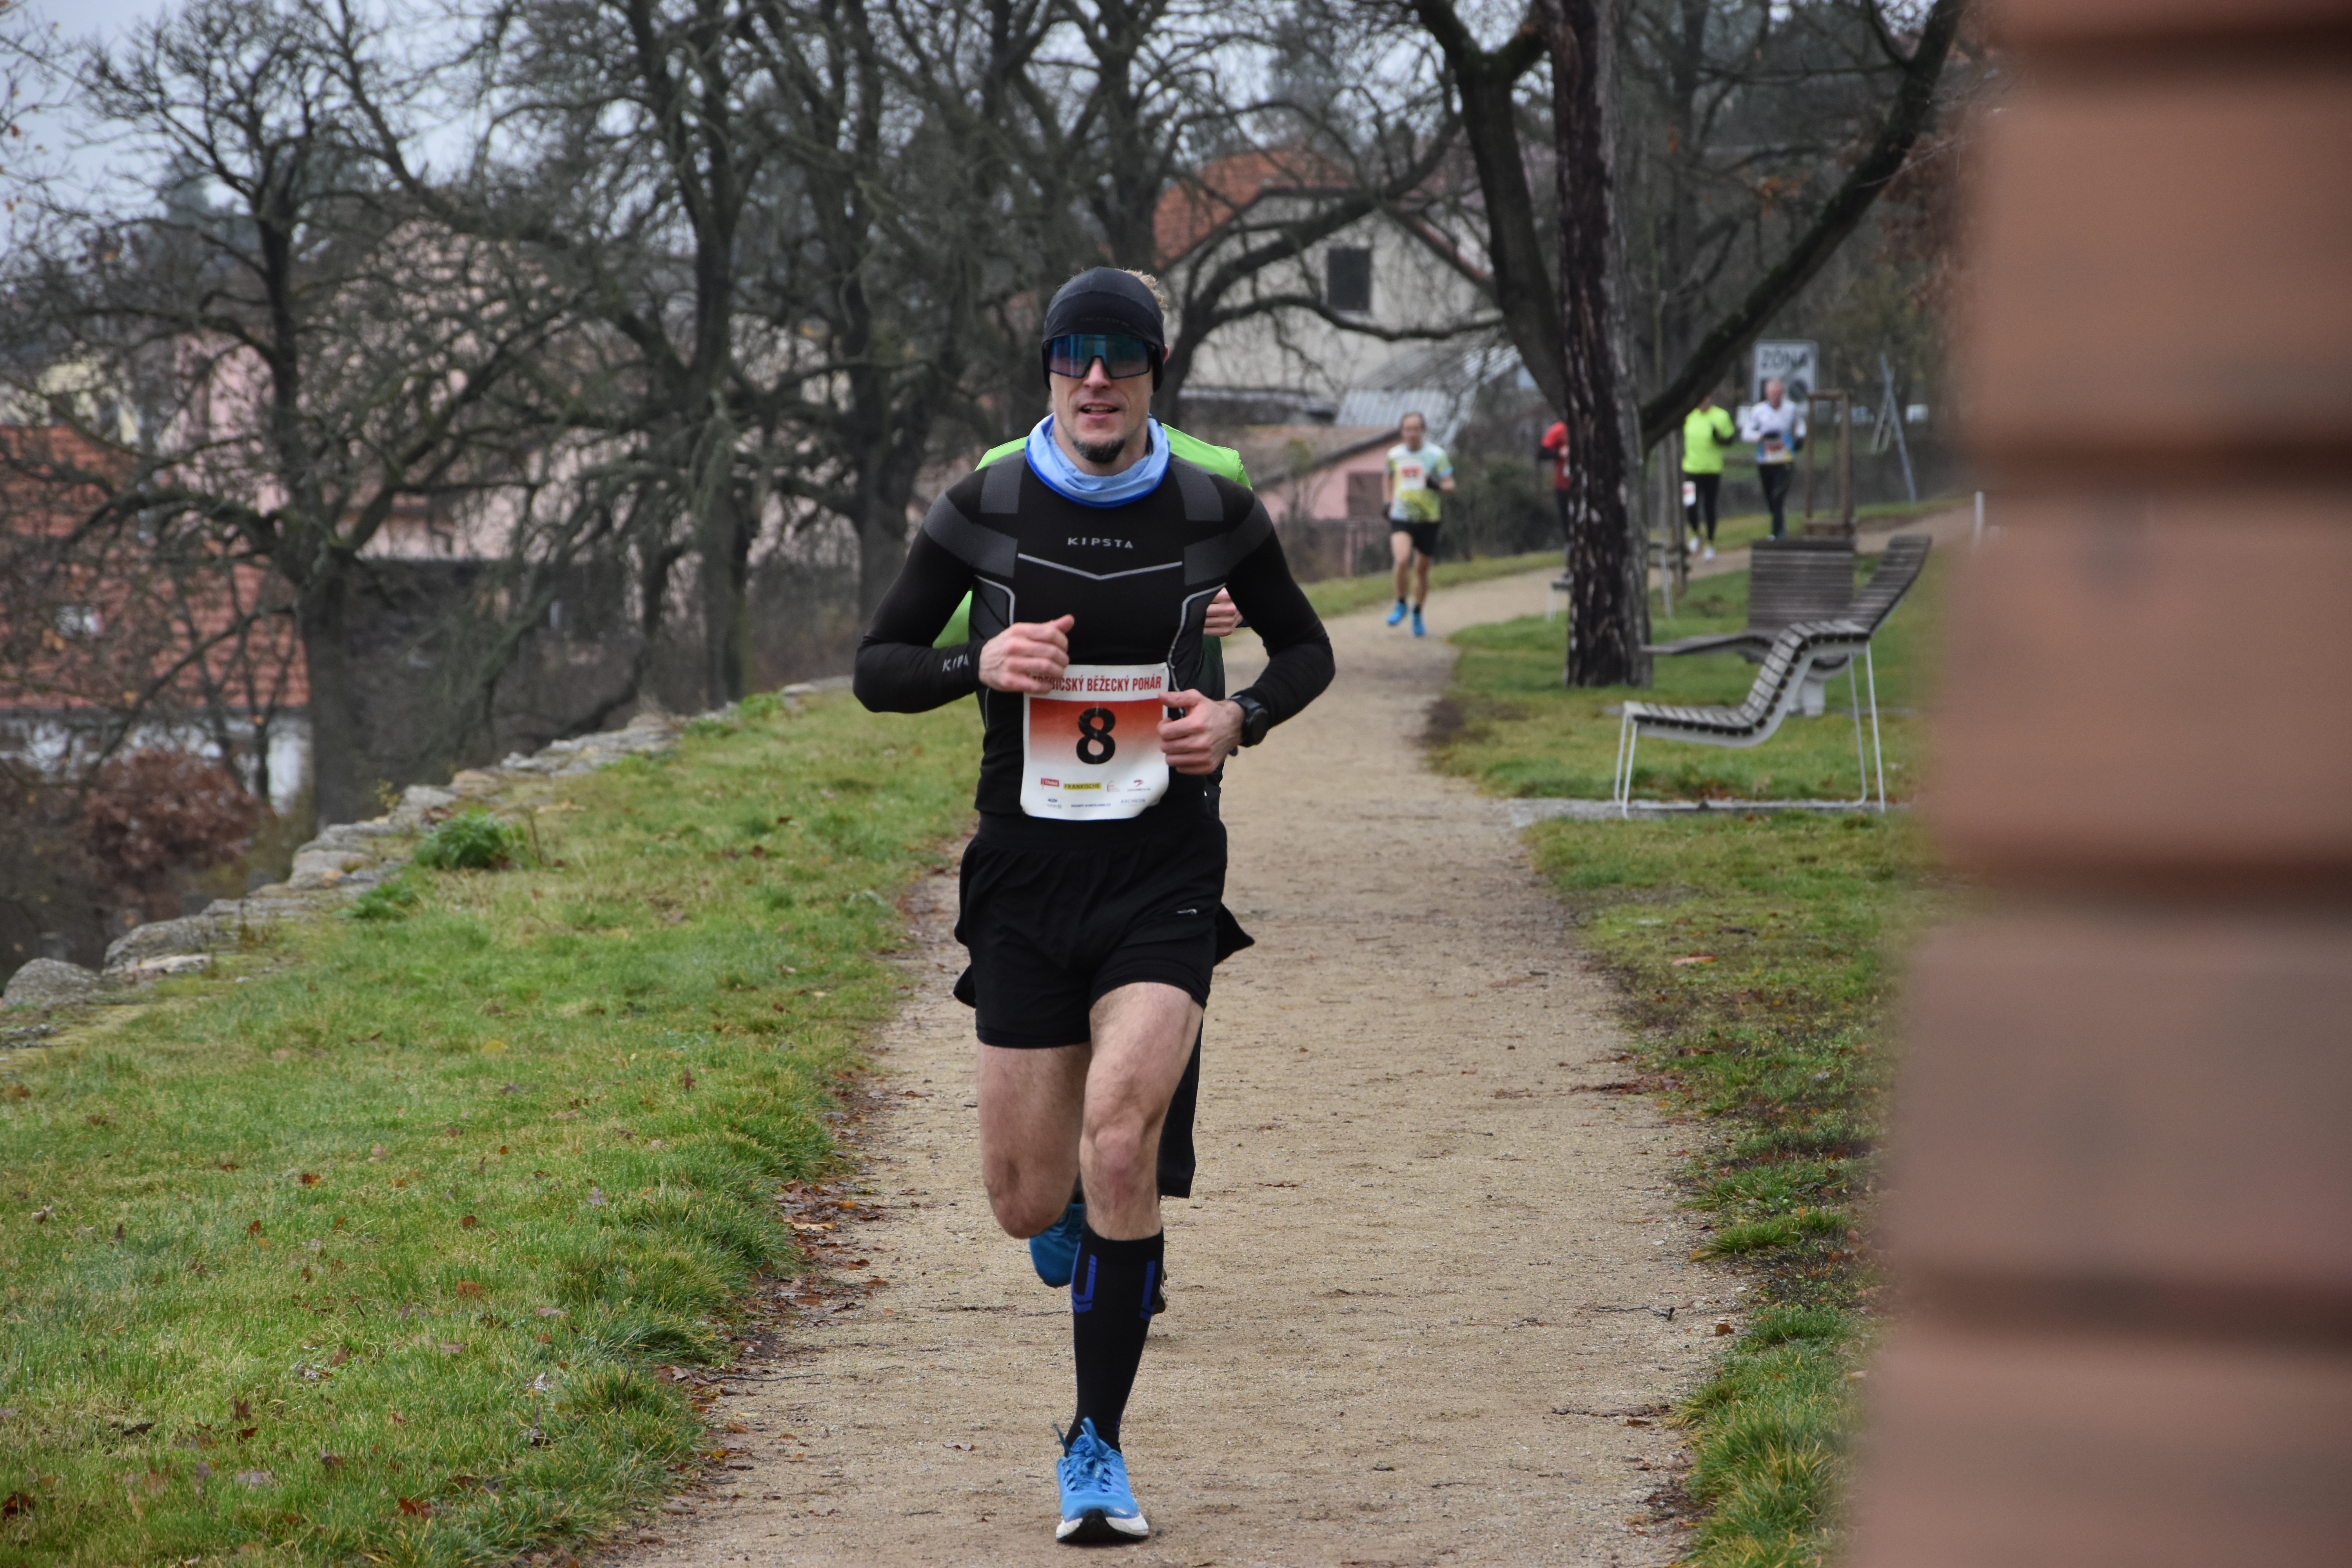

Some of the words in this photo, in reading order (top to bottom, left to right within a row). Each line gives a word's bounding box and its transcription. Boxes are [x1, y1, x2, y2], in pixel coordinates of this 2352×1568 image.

[1068, 537, 1133, 549] KIPSTA
[1087, 675, 1129, 691] BĚŽECKÝ
[1132, 673, 1161, 691] POHÁR
[1076, 707, 1116, 764] 8
